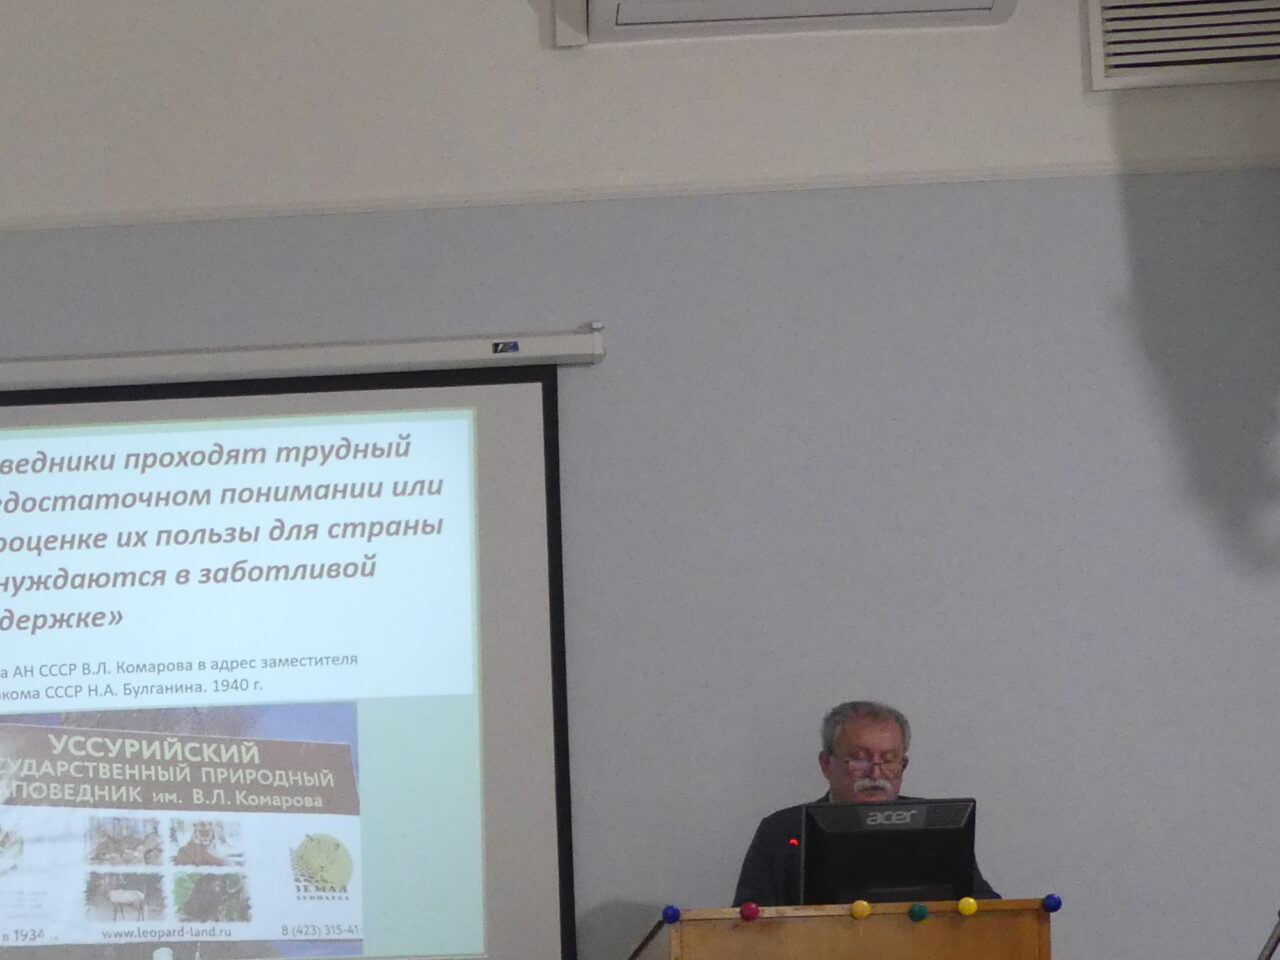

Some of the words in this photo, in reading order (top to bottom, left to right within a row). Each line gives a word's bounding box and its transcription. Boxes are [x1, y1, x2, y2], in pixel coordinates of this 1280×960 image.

[124, 443, 267, 475] проходят
[275, 433, 412, 467] трудный
[220, 480, 383, 505] понимании
[391, 478, 444, 497] или
[116, 530, 148, 549] их
[156, 526, 260, 547] пользы
[268, 518, 320, 542] для
[328, 517, 444, 543] страны
[175, 568, 190, 585] в
[198, 553, 377, 584] заботливой
[13, 665, 34, 678] АН
[39, 663, 77, 678] СССР
[82, 661, 111, 676] В.Л.
[116, 660, 193, 677] Комарова
[198, 660, 207, 671] в
[211, 657, 256, 673] адрес
[261, 654, 359, 669] заместителя
[45, 684, 83, 700] СССР
[87, 683, 118, 698] Н.А.
[213, 678, 249, 693] 1940
[254, 680, 263, 692] г.
[48, 733, 260, 765] УССУРИЙСКИЙ
[201, 767, 335, 788] ПРИРОДНЫЙ
[152, 791, 183, 805] им.
[192, 788, 231, 806] В.Л.
[236, 790, 324, 810] Комарова
[865, 810, 919, 826] acer
[101, 925, 232, 940] www.leopard-land.ru
[281, 924, 289, 936] 8
[292, 924, 322, 938] (423)
